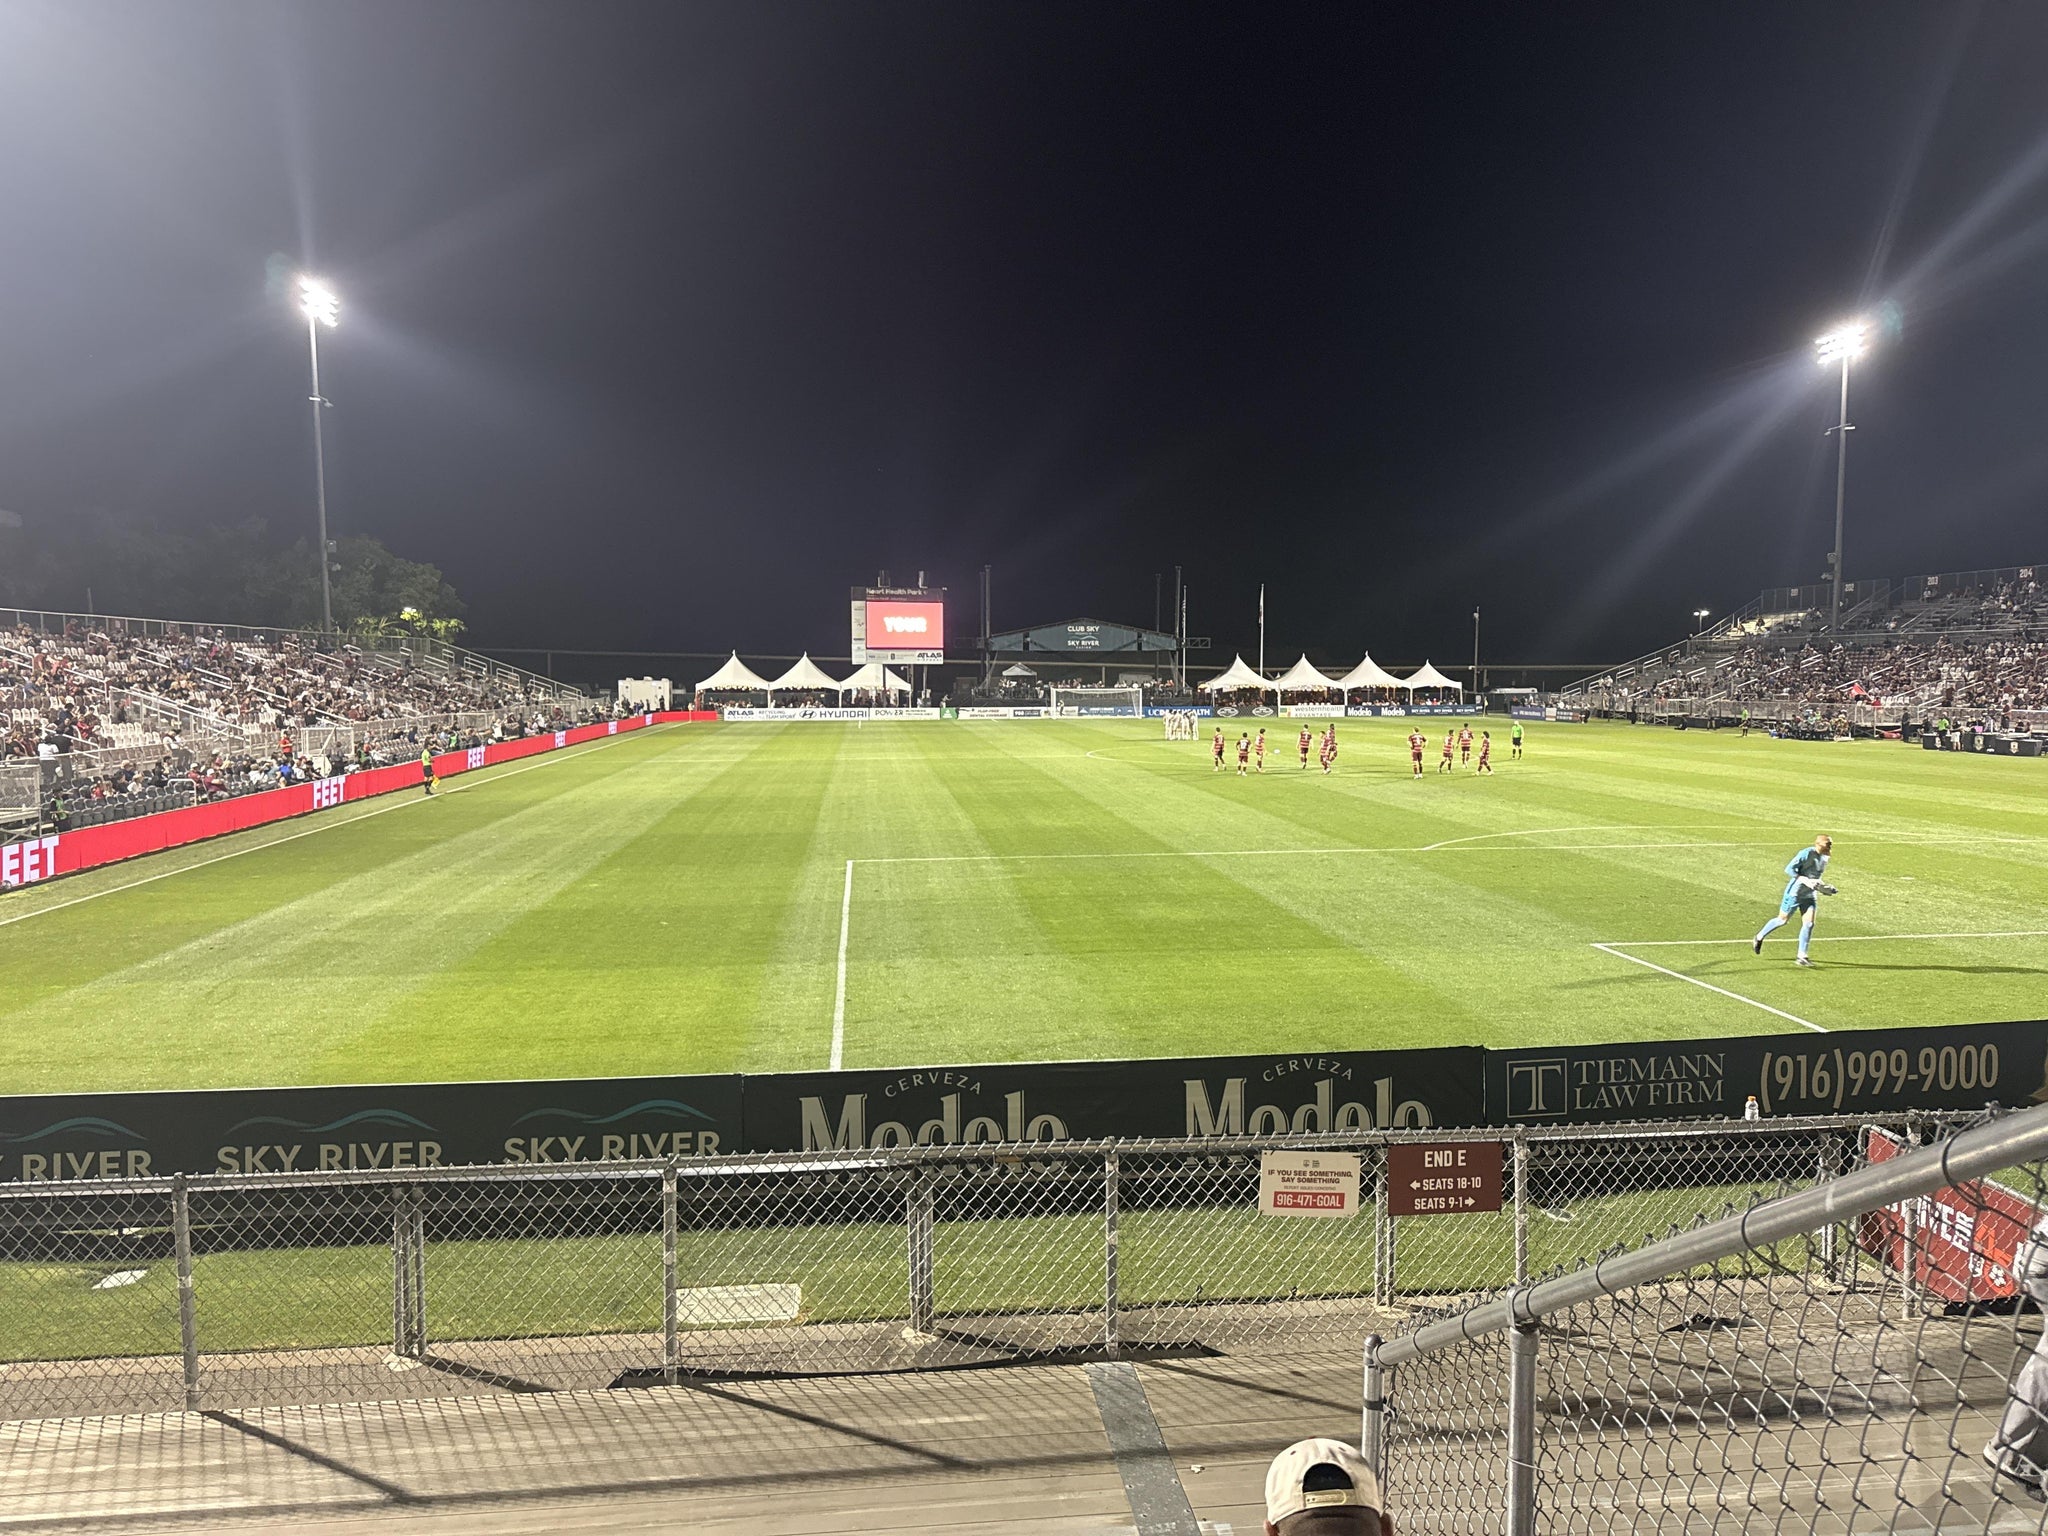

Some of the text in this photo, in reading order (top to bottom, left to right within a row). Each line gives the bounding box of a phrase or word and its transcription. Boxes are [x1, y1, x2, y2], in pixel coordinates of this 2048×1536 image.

[1927, 576, 1939, 585] 203
[2019, 568, 2033, 579] 204
[819, 710, 867, 718] HYUNDAI
[1347, 706, 1372, 717] Modelo
[1381, 706, 1405, 717] Modelo
[467, 745, 486, 769] FEET
[313, 774, 346, 810] FEET
[0, 835, 60, 887] EET
[1262, 1057, 1353, 1083] CERVEZA
[1573, 1053, 1726, 1086] TIEMANN
[1760, 1043, 2000, 1113] (916)999-9000
[884, 1071, 982, 1098] CERVEZA
[1574, 1078, 1725, 1111] LAW FIRM
[216, 1139, 443, 1175] SKY RIVER
[503, 1130, 721, 1165] SKY RIVER
[1424, 1149, 1467, 1168] END E
[22, 1149, 152, 1182] RIVER
[1422, 1176, 1482, 1191] SEATS 18-10
[1276, 1193, 1342, 1208] 916-471-GOAL
[1414, 1196, 1463, 1210] SEATS 9-1
